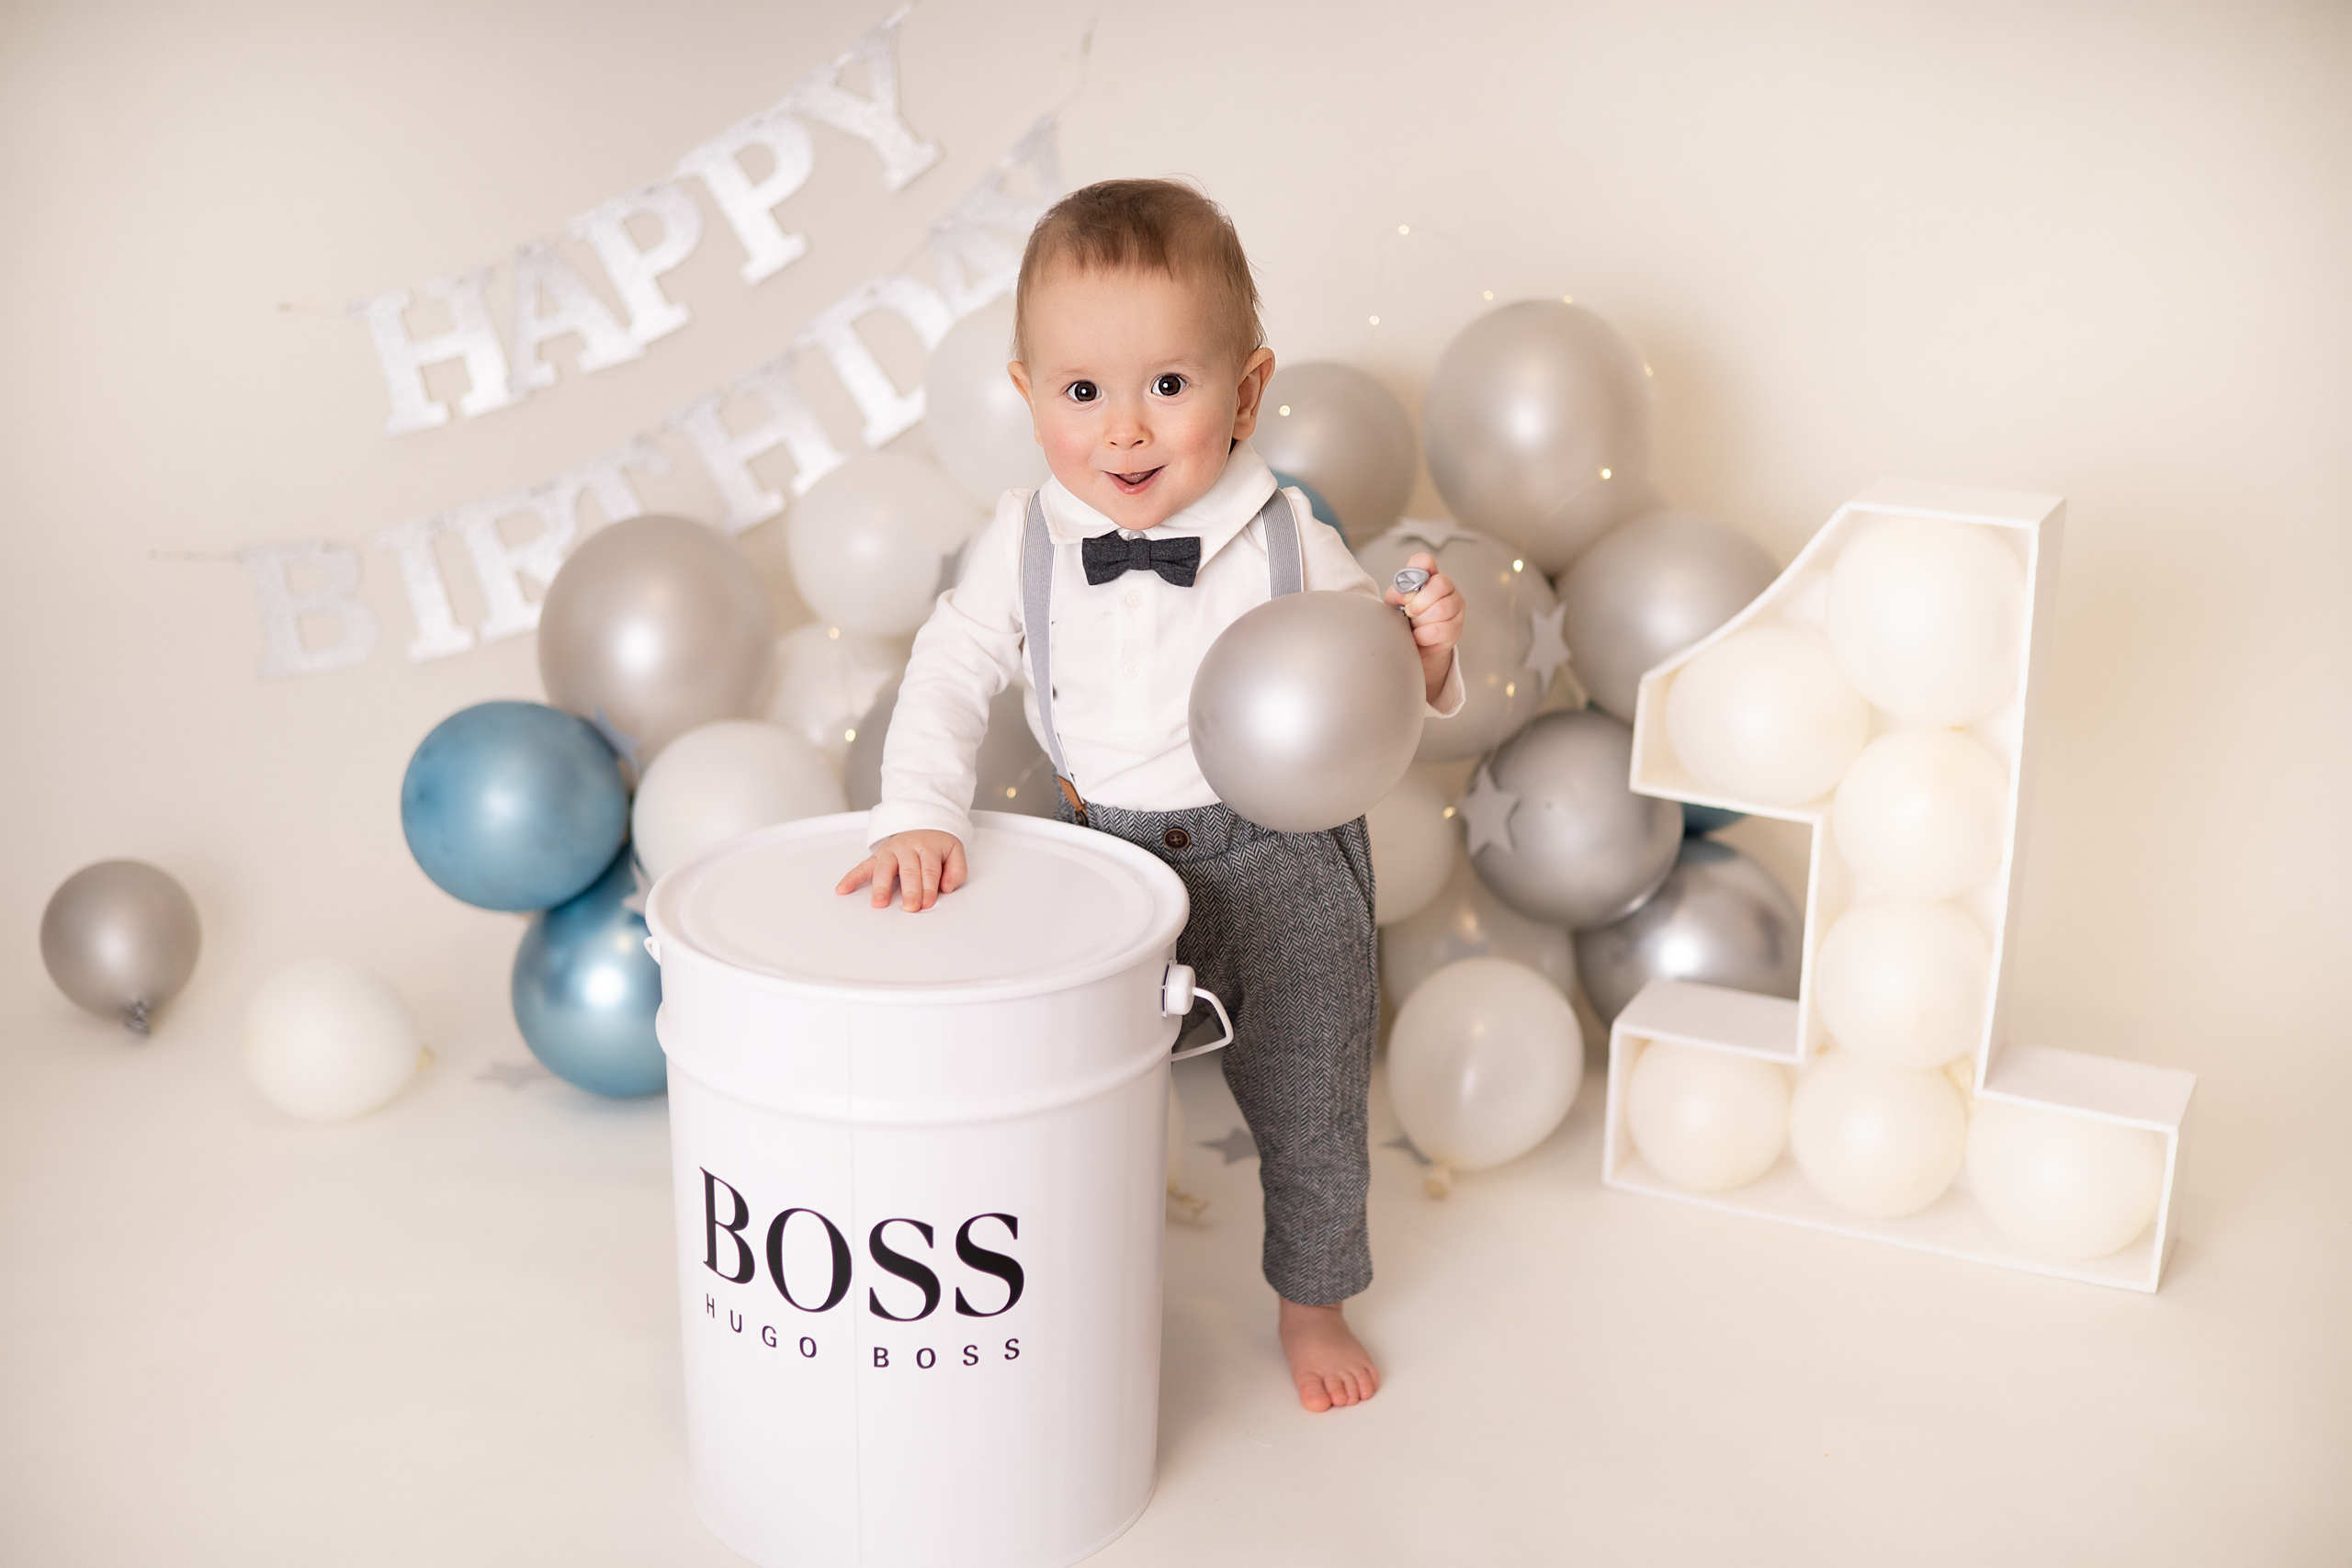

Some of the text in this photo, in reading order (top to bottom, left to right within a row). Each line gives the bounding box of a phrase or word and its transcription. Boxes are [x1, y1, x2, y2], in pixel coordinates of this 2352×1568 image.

[355, 9, 944, 437] HAPPY
[699, 1166, 1025, 1322] BOSS
[706, 1292, 1021, 1370] HUGO BOSS
